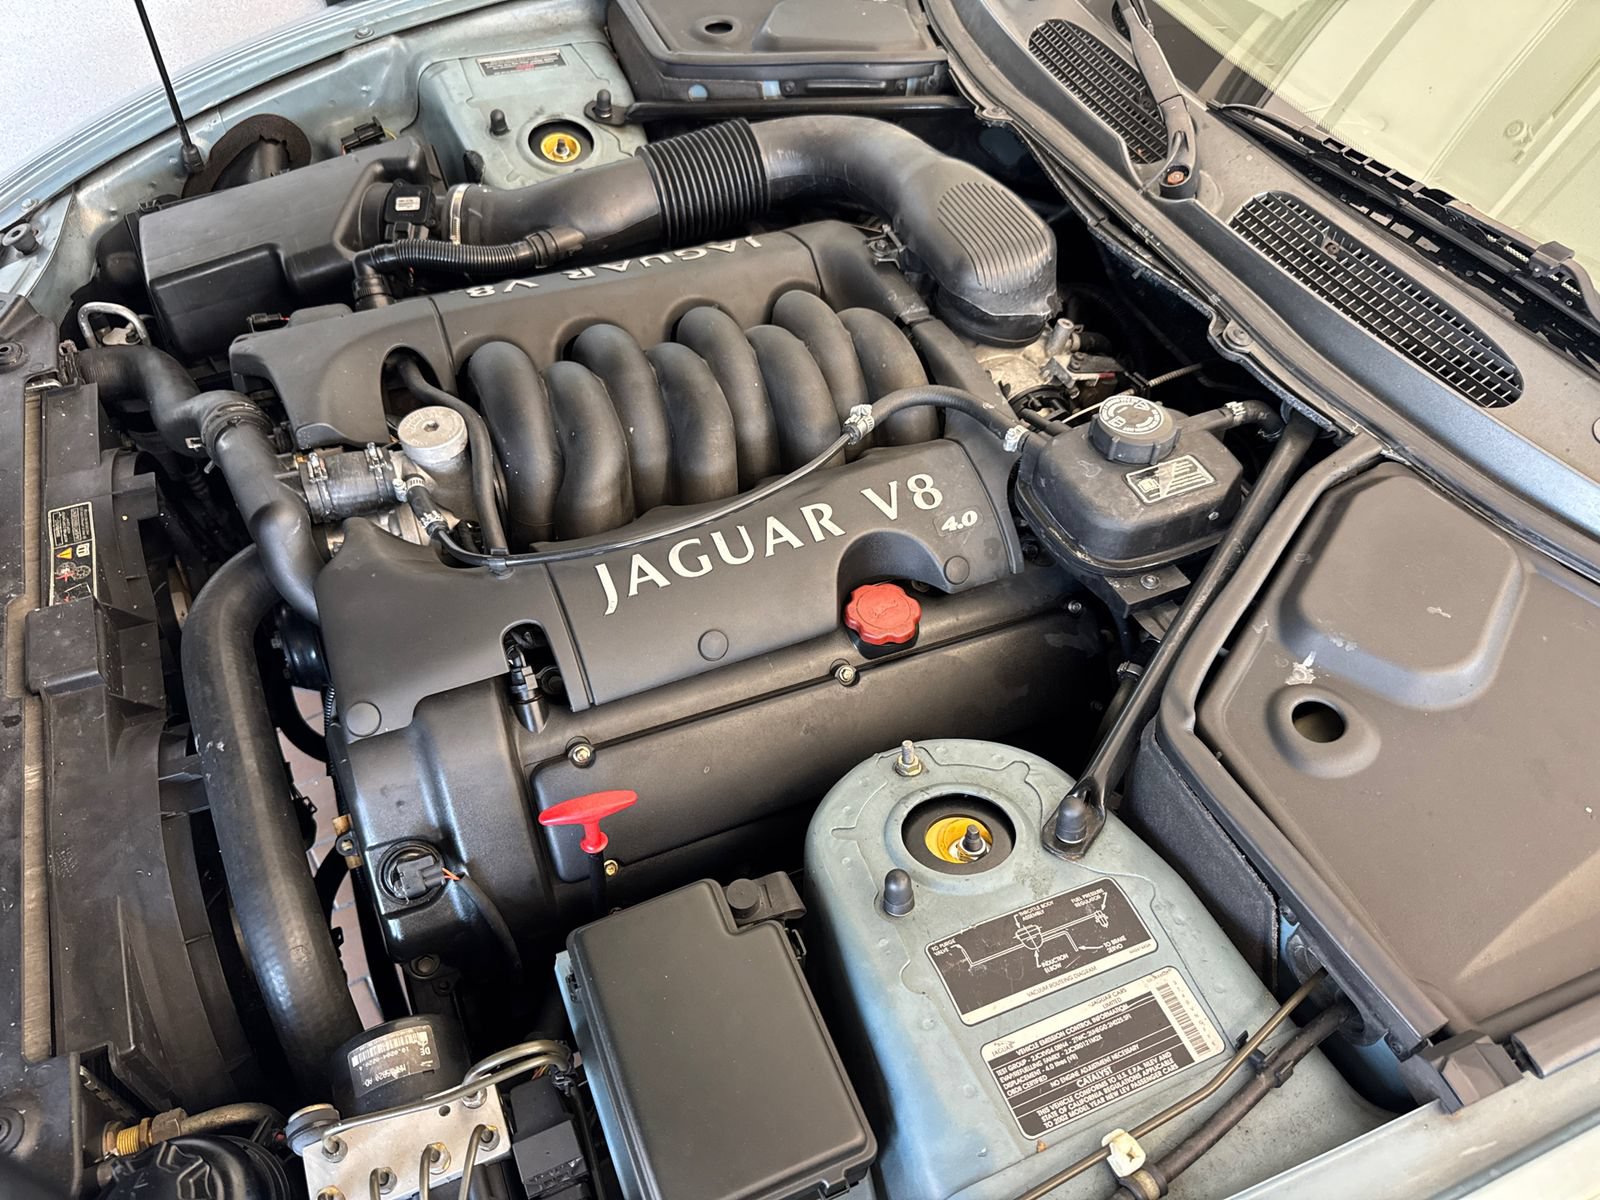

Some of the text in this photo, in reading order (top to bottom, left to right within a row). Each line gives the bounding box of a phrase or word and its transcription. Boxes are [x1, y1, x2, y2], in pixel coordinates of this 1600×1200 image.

[466, 279, 539, 299] V8
[941, 510, 978, 531] 4.0
[595, 473, 944, 616] JAGUAR V8
[1070, 887, 1104, 903] FUEL PRESSURE
[938, 938, 956, 948] PURGE
[1102, 935, 1126, 948] TO BRAKE
[1106, 943, 1124, 953] SERVO
[933, 946, 949, 956] VALVE
[1040, 953, 1069, 967] INDUCTION
[1043, 962, 1062, 973] ELBOW
[1026, 984, 1048, 997] VACUUM
[1072, 965, 1097, 978] DIAGRAM
[1111, 987, 1127, 997] CARS
[1102, 997, 1122, 1008] LIMITED
[1015, 1003, 1129, 1056] VEHICLE EMISSION CONTROL INFORMATION
[995, 1066, 1008, 1076] TEST
[1006, 1058, 1027, 1071] GROUP
[1042, 1052, 1061, 1064] FAMILY
[1049, 1043, 1140, 1087] NO ENGINE ADJUSTMENT NECESSARY
[1002, 1068, 1041, 1089] DISPLACEMENT
[1044, 1063, 1055, 1071] 4.0
[1021, 1074, 1048, 1089] CERTIFIED
[1036, 1106, 1050, 1116] THIS
[1049, 1095, 1074, 1110] VEHICLE
[1073, 1080, 1108, 1099] CONFORMS
[1107, 1075, 1117, 1084] TO
[1142, 1057, 1159, 1068] NLEV
[1157, 1051, 1172, 1061] AND
[1075, 1066, 1113, 1088] CATALYST
[1040, 1057, 1174, 1122] STATE OF CALIFORNIA REGULATIONS APPLICABLE
[1043, 1063, 1179, 1129] TO 2002 MODEL YEAR NEW LEV PASSENGER CARS
